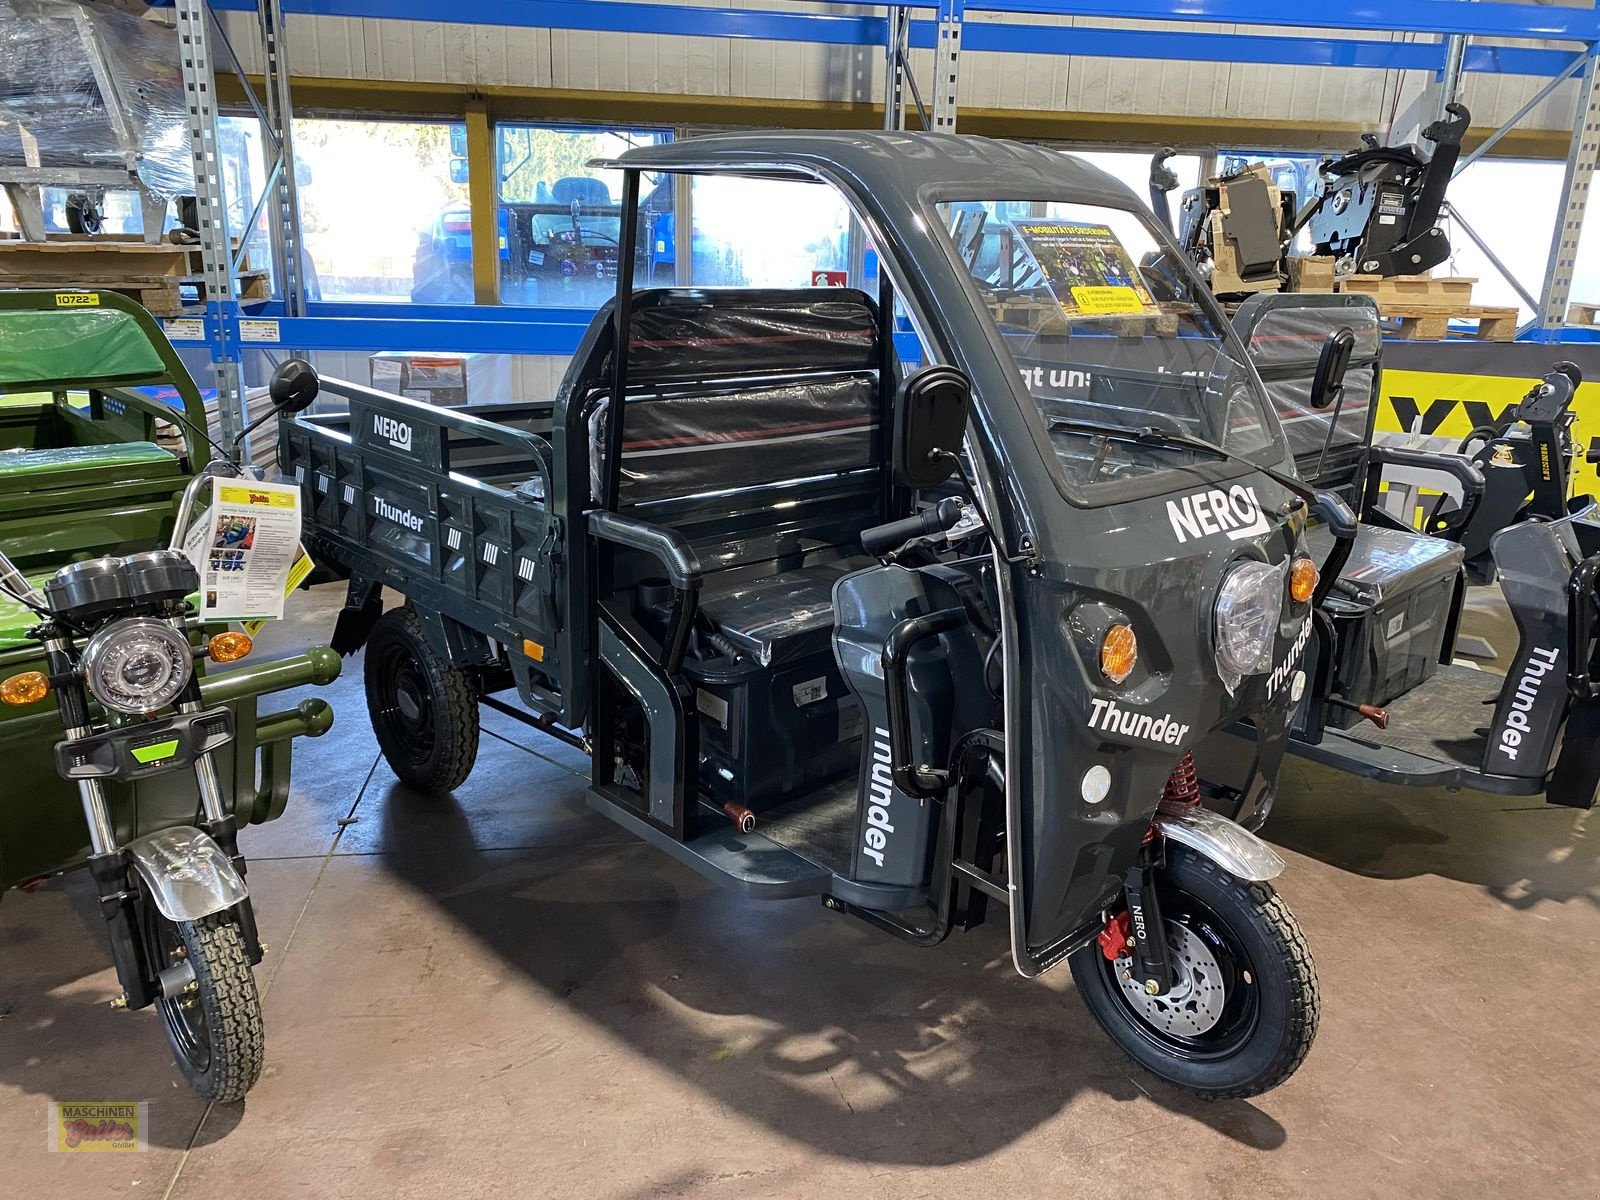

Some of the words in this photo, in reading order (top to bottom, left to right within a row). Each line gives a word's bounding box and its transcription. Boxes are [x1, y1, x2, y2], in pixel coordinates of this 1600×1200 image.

[57, 295, 90, 304] 10722
[373, 414, 412, 451] NERO
[374, 496, 424, 532] Thunder
[1166, 484, 1271, 543] NERO
[1087, 698, 1190, 746] Thunder
[1498, 646, 1560, 761] Thunder
[1132, 905, 1147, 940] NERO
